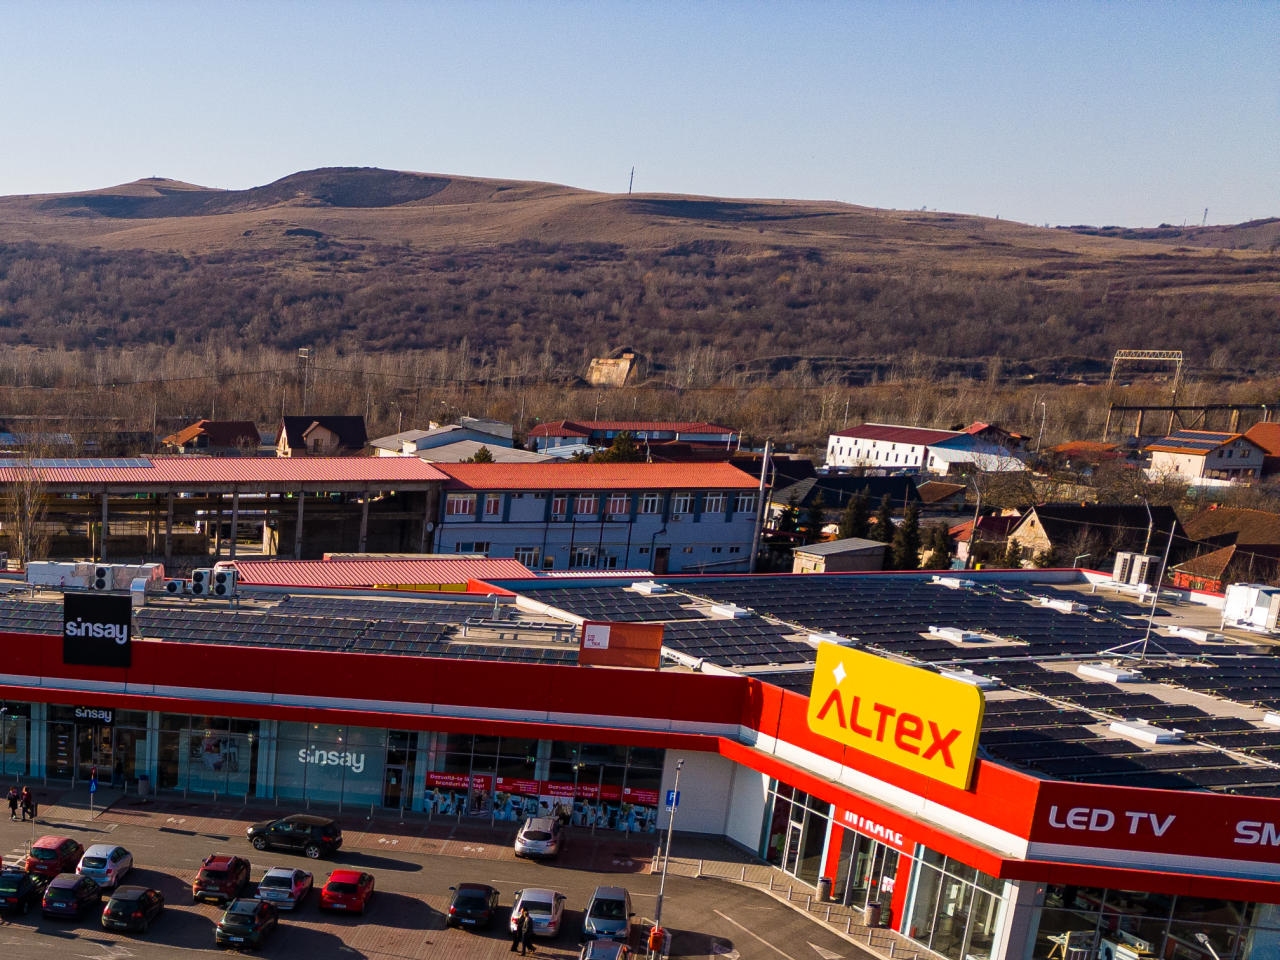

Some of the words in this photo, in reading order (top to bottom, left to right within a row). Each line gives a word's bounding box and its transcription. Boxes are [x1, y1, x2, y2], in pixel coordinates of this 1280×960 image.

[66, 617, 128, 645] sinsay
[75, 706, 112, 723] sinsay
[298, 745, 365, 773] sinsay
[1048, 805, 1116, 832] LED
[1125, 811, 1177, 837] TV
